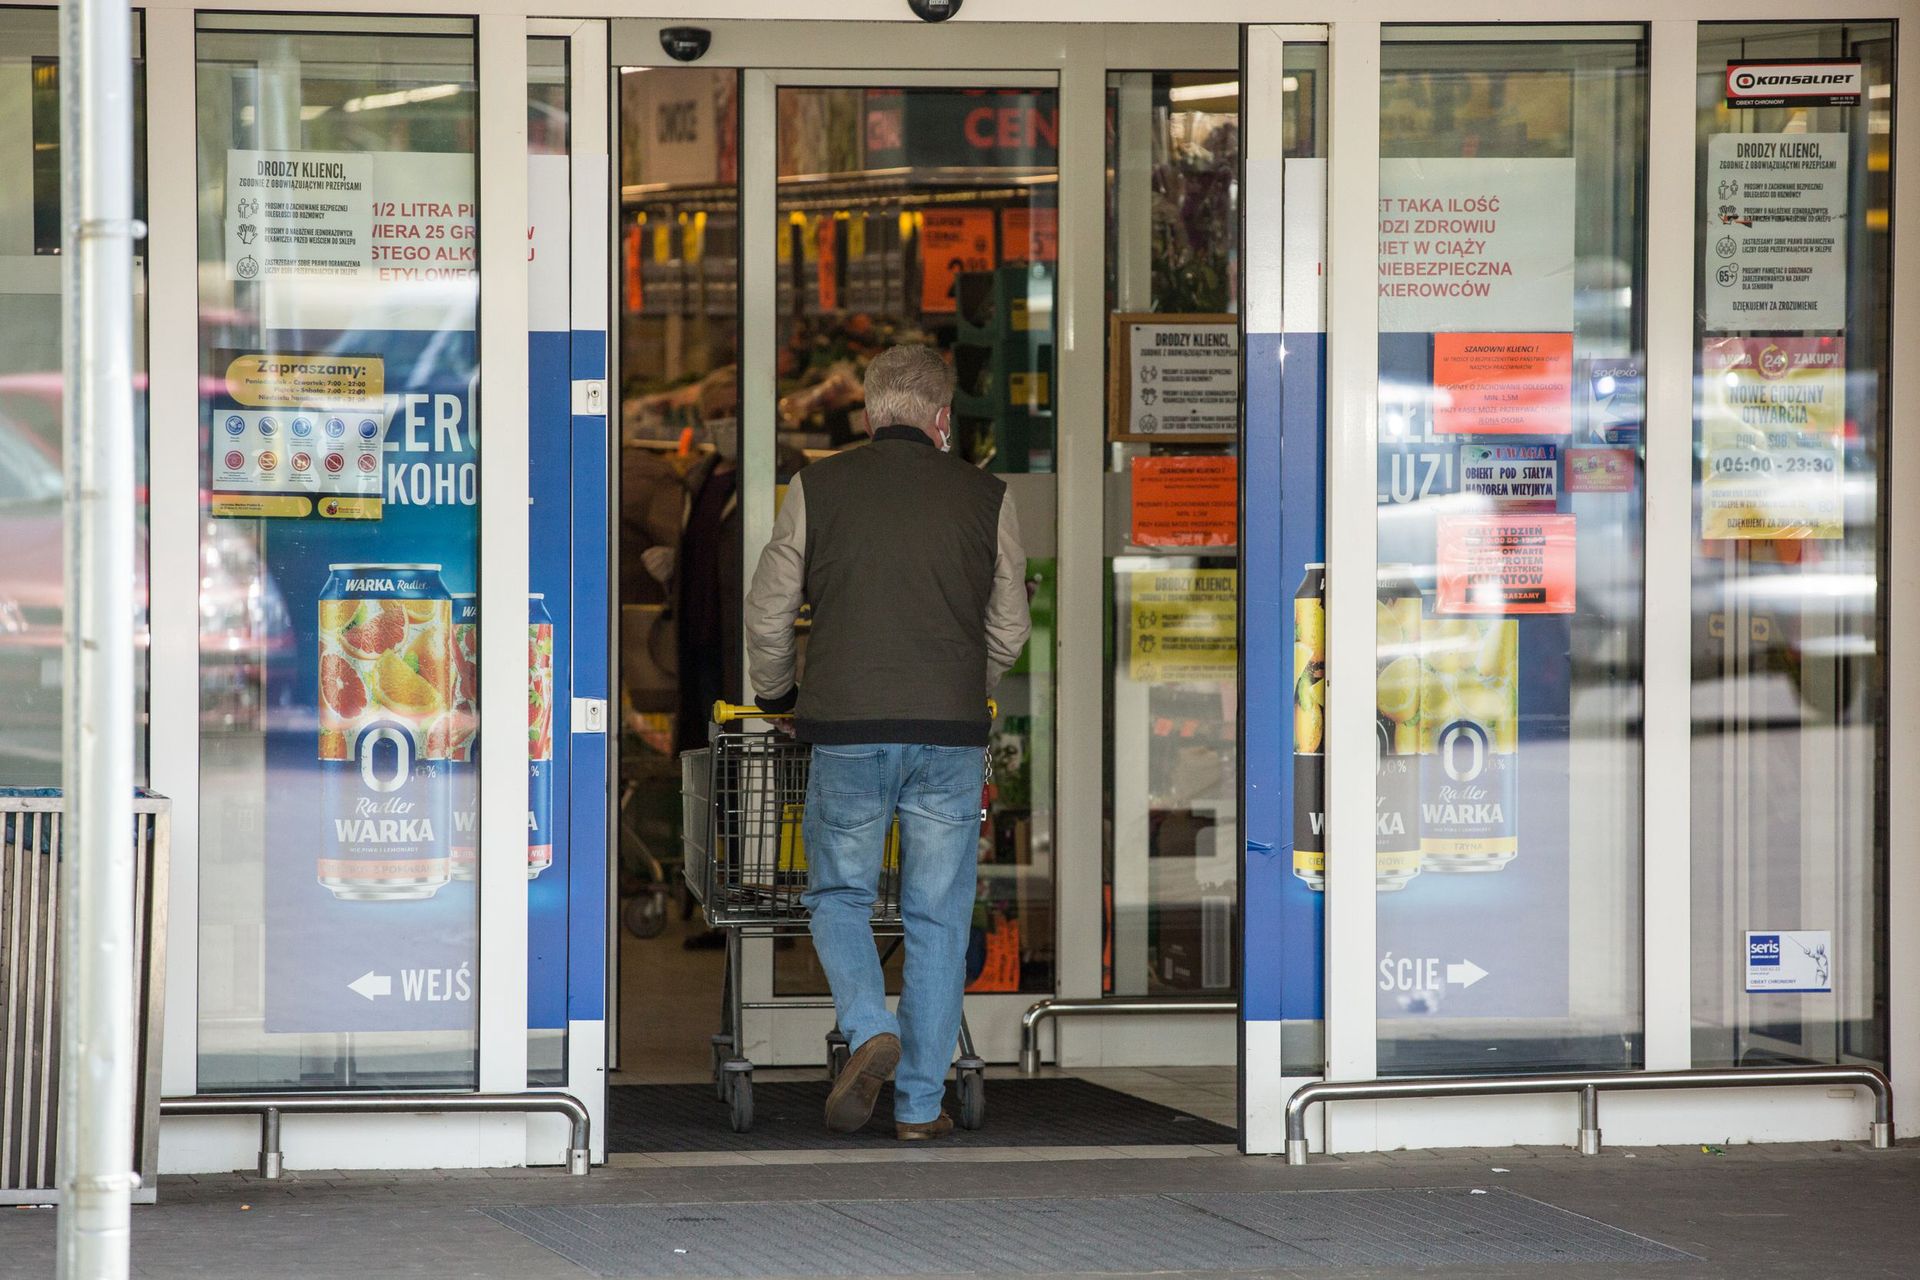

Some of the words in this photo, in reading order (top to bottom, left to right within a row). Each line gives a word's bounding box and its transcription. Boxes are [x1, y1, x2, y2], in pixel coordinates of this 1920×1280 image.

[1736, 142, 1778, 158] DRODZY
[1780, 142, 1822, 160] KLIENCI,
[258, 160, 299, 177] DRODZY
[302, 162, 346, 181] KLIENCI,
[1720, 160, 1744, 170] ZGODNIE
[1745, 161, 1749, 170] Z
[1750, 160, 1800, 172] OBOWIĄZUJĄCYMI
[1801, 160, 1837, 170] PRZEPISAMI
[326, 181, 362, 191] PRZEPISAMI
[372, 202, 396, 216] 1/2
[401, 203, 453, 217] LITRA
[1398, 198, 1444, 213] TAKA
[1448, 195, 1500, 213] ILOŚĆ
[425, 225, 445, 239] 25
[1379, 220, 1409, 234] DZI
[1414, 220, 1496, 234] ZDROWIU
[1414, 240, 1430, 254] W
[1435, 238, 1486, 258] CIĄŻY
[1719, 270, 1735, 282] 65+
[1378, 280, 1491, 297] KIEROWCÓW
[1732, 301, 1768, 312] DZIĘKUJEMY
[1770, 302, 1777, 310] ZA
[1778, 301, 1818, 310] ZROZUMIENIE
[1155, 333, 1192, 347] DRODZY
[1794, 354, 1840, 364] ZAKUPY
[257, 360, 366, 378] Zapraszamy:
[1593, 368, 1638, 378] sodexo
[1730, 385, 1767, 404] NOWE
[1770, 384, 1824, 402] GODZINY
[1743, 406, 1808, 424] OTWARCIA
[1786, 457, 1834, 472] 23:30
[1466, 466, 1494, 480] OBIEKT
[1500, 467, 1517, 480] POD
[1522, 466, 1554, 480] STAŁYM
[1466, 484, 1508, 496] NADZOREM
[1511, 484, 1554, 497] WIZYJNYM
[1496, 524, 1544, 536] TYDZIEŃ
[345, 578, 395, 592] WARKA
[1422, 802, 1504, 824] WARKA
[334, 818, 435, 844] WARKA
[1750, 939, 1780, 954] seris
[1379, 951, 1440, 991] ŚCIE
[400, 961, 471, 1002] WEJŚ
